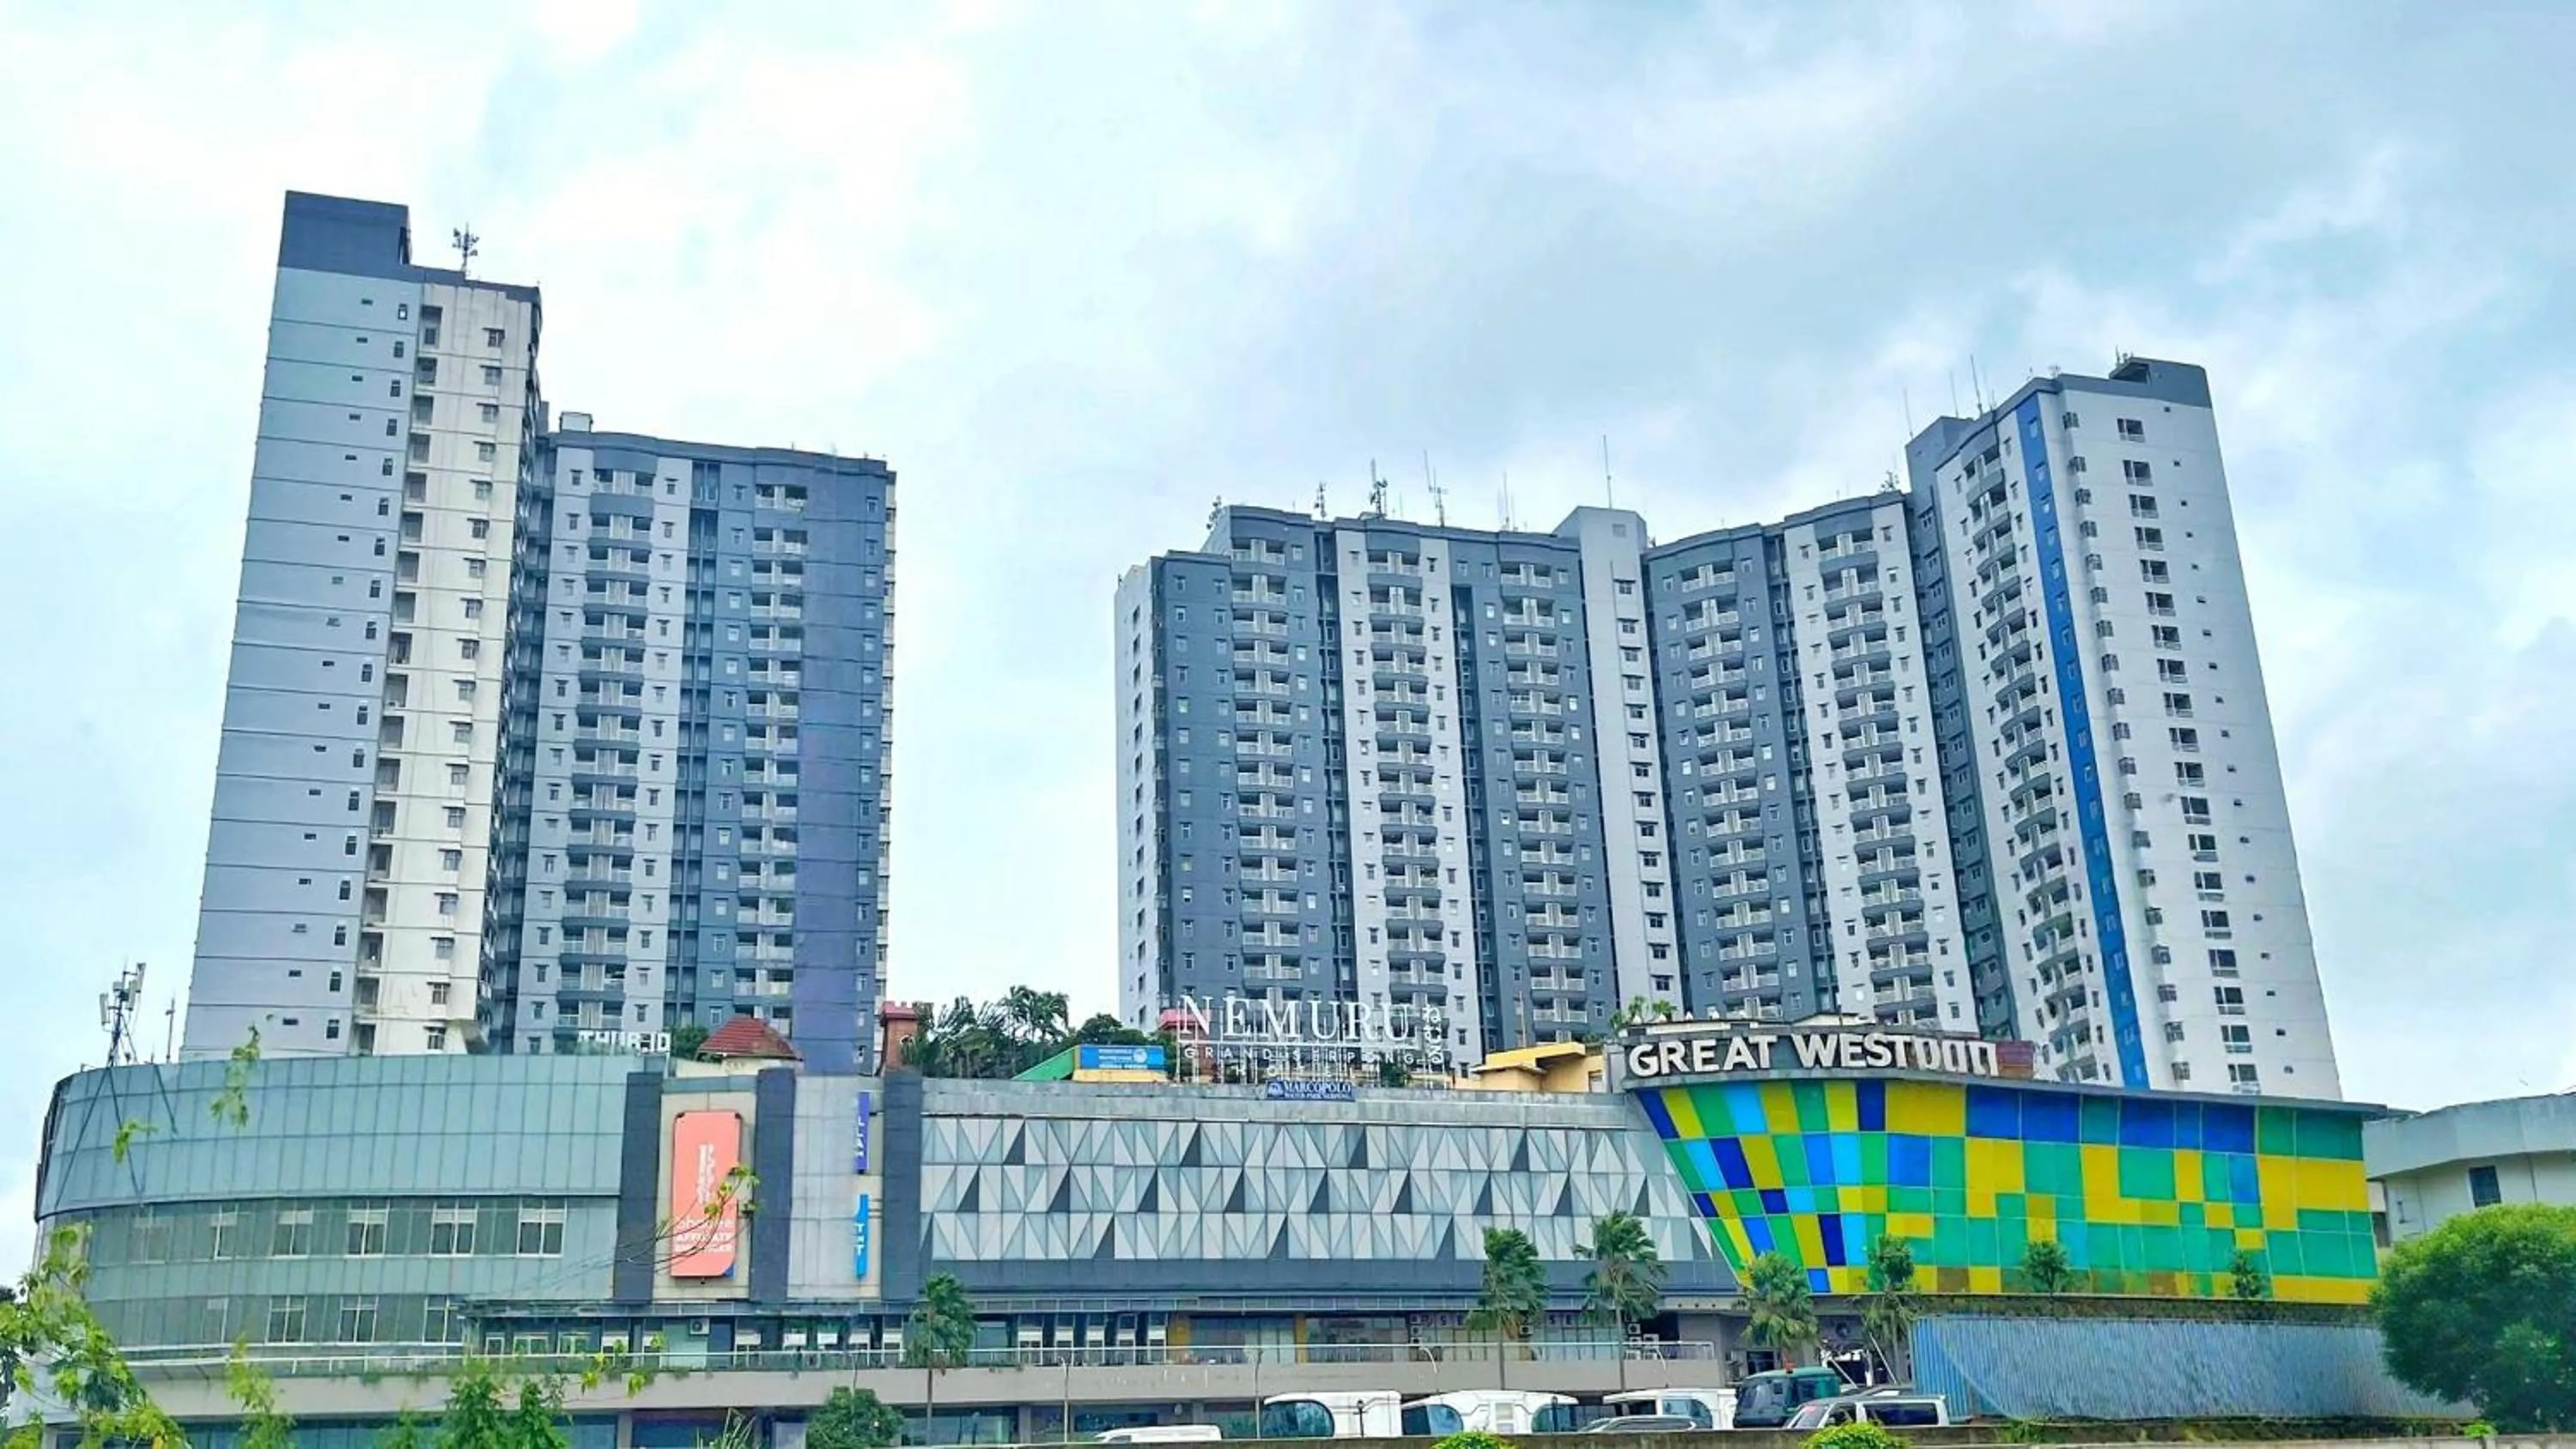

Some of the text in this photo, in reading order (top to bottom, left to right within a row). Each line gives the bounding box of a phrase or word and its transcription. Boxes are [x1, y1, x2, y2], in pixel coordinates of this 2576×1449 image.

[1178, 994, 1411, 1041] NEMURU
[1184, 1046, 1272, 1059] GRAND
[1629, 1036, 1777, 1077] GREAT
[1284, 1081, 1351, 1093] MARCOPOLO
